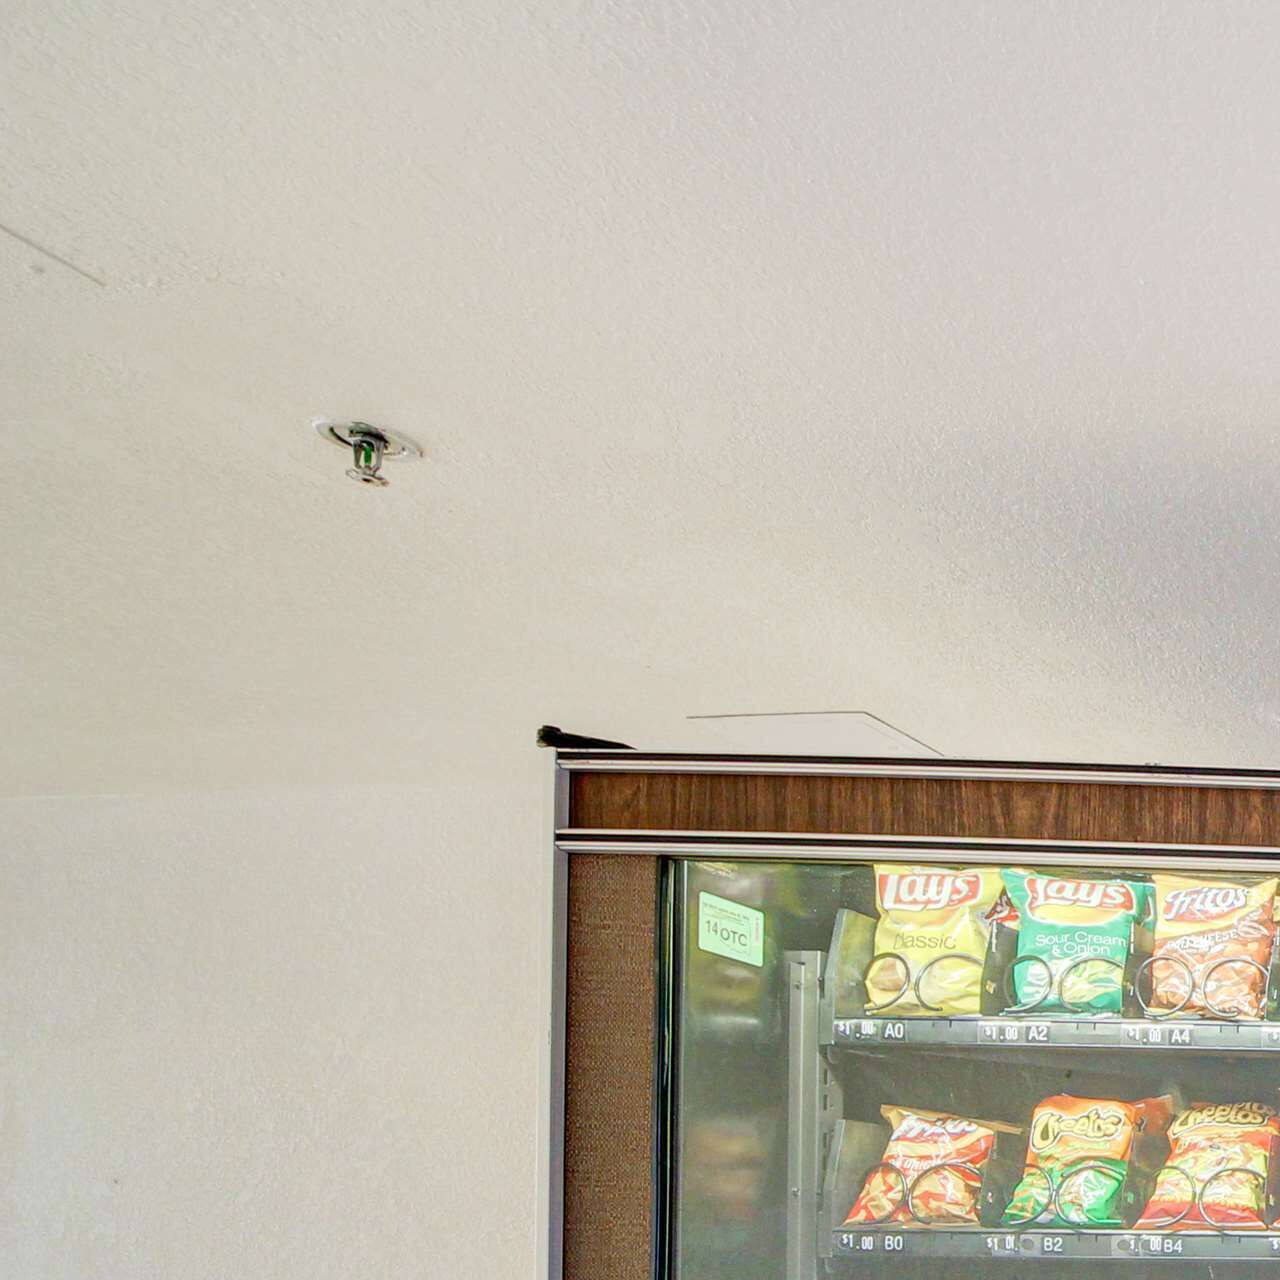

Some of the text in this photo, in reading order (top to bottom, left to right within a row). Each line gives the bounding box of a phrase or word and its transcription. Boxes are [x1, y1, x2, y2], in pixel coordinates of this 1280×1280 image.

[1164, 887, 1249, 921] Fritos
[704, 919, 719, 935] 14
[720, 927, 748, 946] OTC
[1035, 931, 1127, 948] Sour Cream
[1052, 942, 1111, 956] & Onion
[884, 1023, 905, 1038] A0
[985, 1025, 1048, 1041] $1.00 A2
[1129, 1027, 1190, 1043] $1.00 A4
[1031, 1107, 1124, 1151] Cheetos
[842, 1234, 903, 1250] $1.00 B0
[1043, 1238, 1063, 1252] B2
[1163, 1239, 1183, 1253] B4
